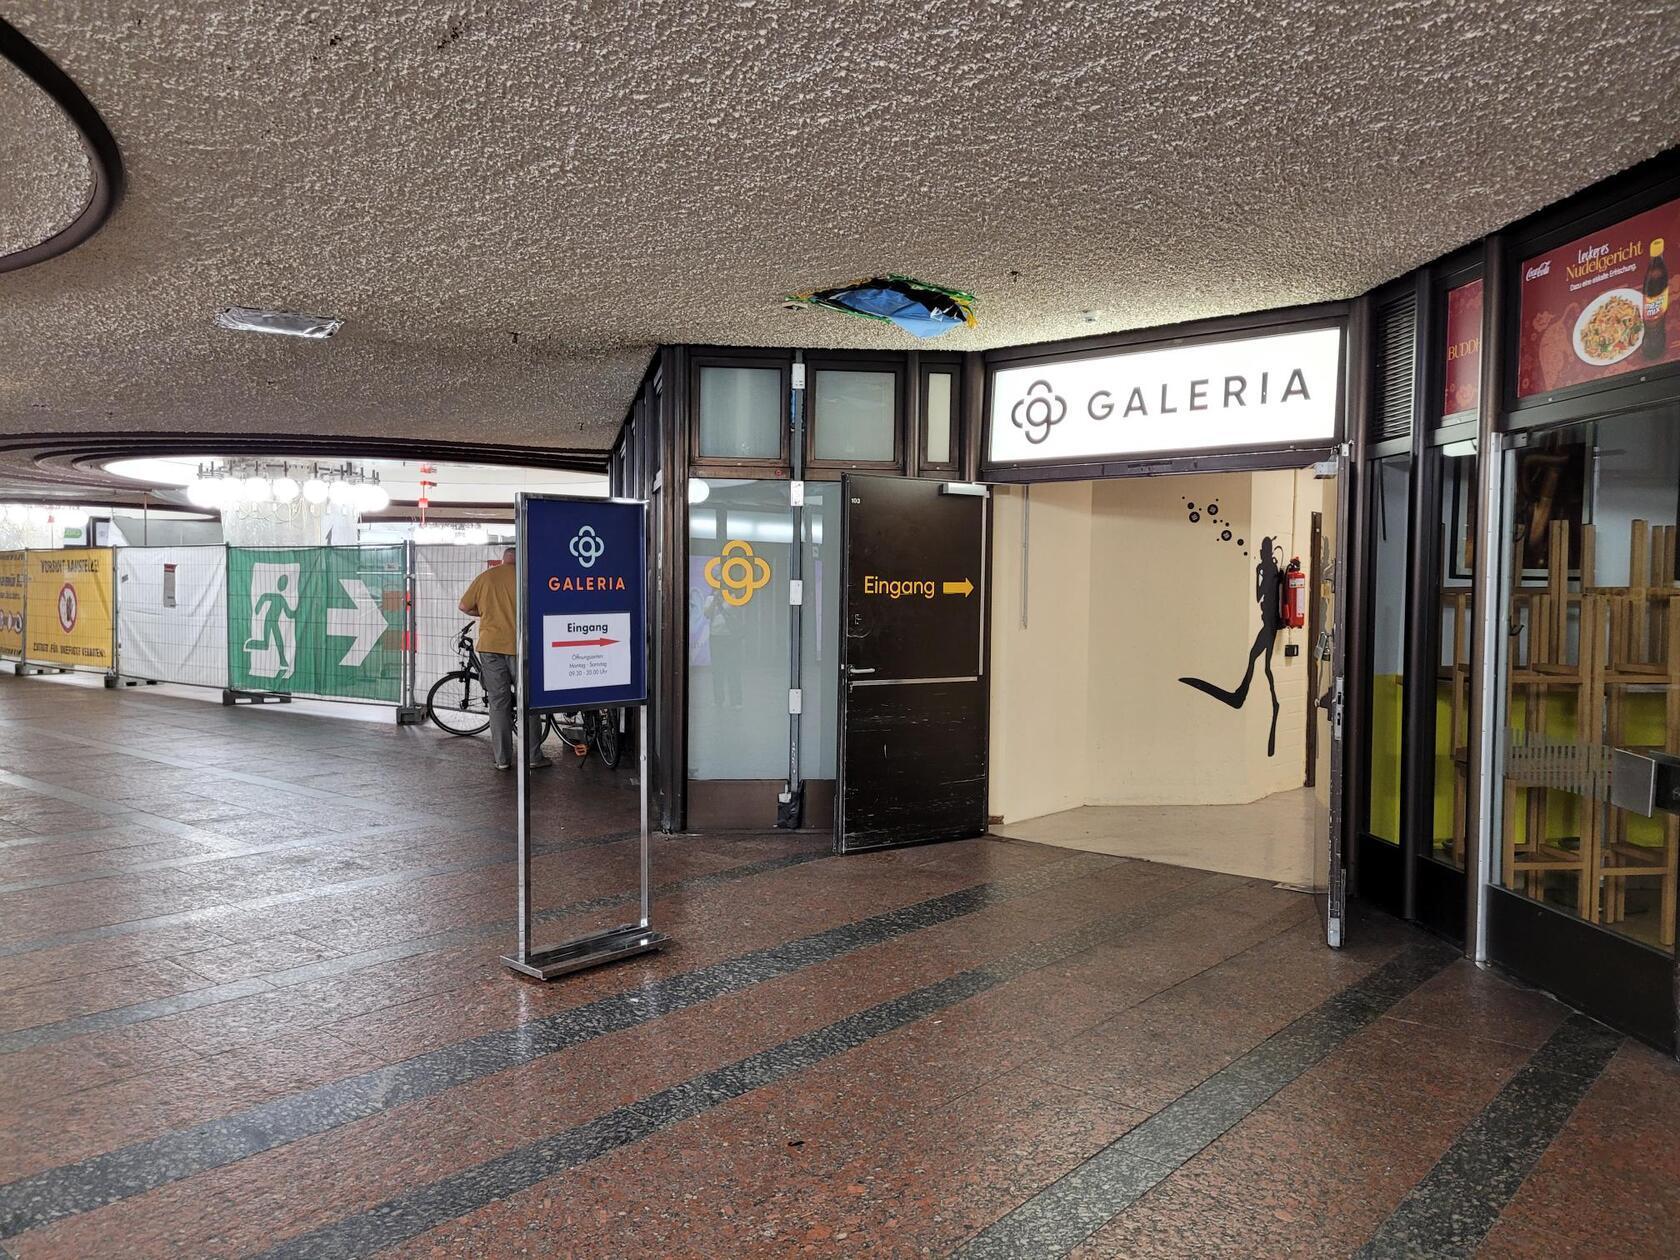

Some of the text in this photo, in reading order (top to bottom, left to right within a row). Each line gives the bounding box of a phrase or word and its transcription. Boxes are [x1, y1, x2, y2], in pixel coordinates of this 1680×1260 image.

[1566, 240, 1643, 281] Nudelgericht
[1087, 368, 1312, 421] GALERIA
[548, 576, 625, 591] GALERIA
[864, 575, 935, 599] Eingang
[567, 622, 608, 634] Eingang
